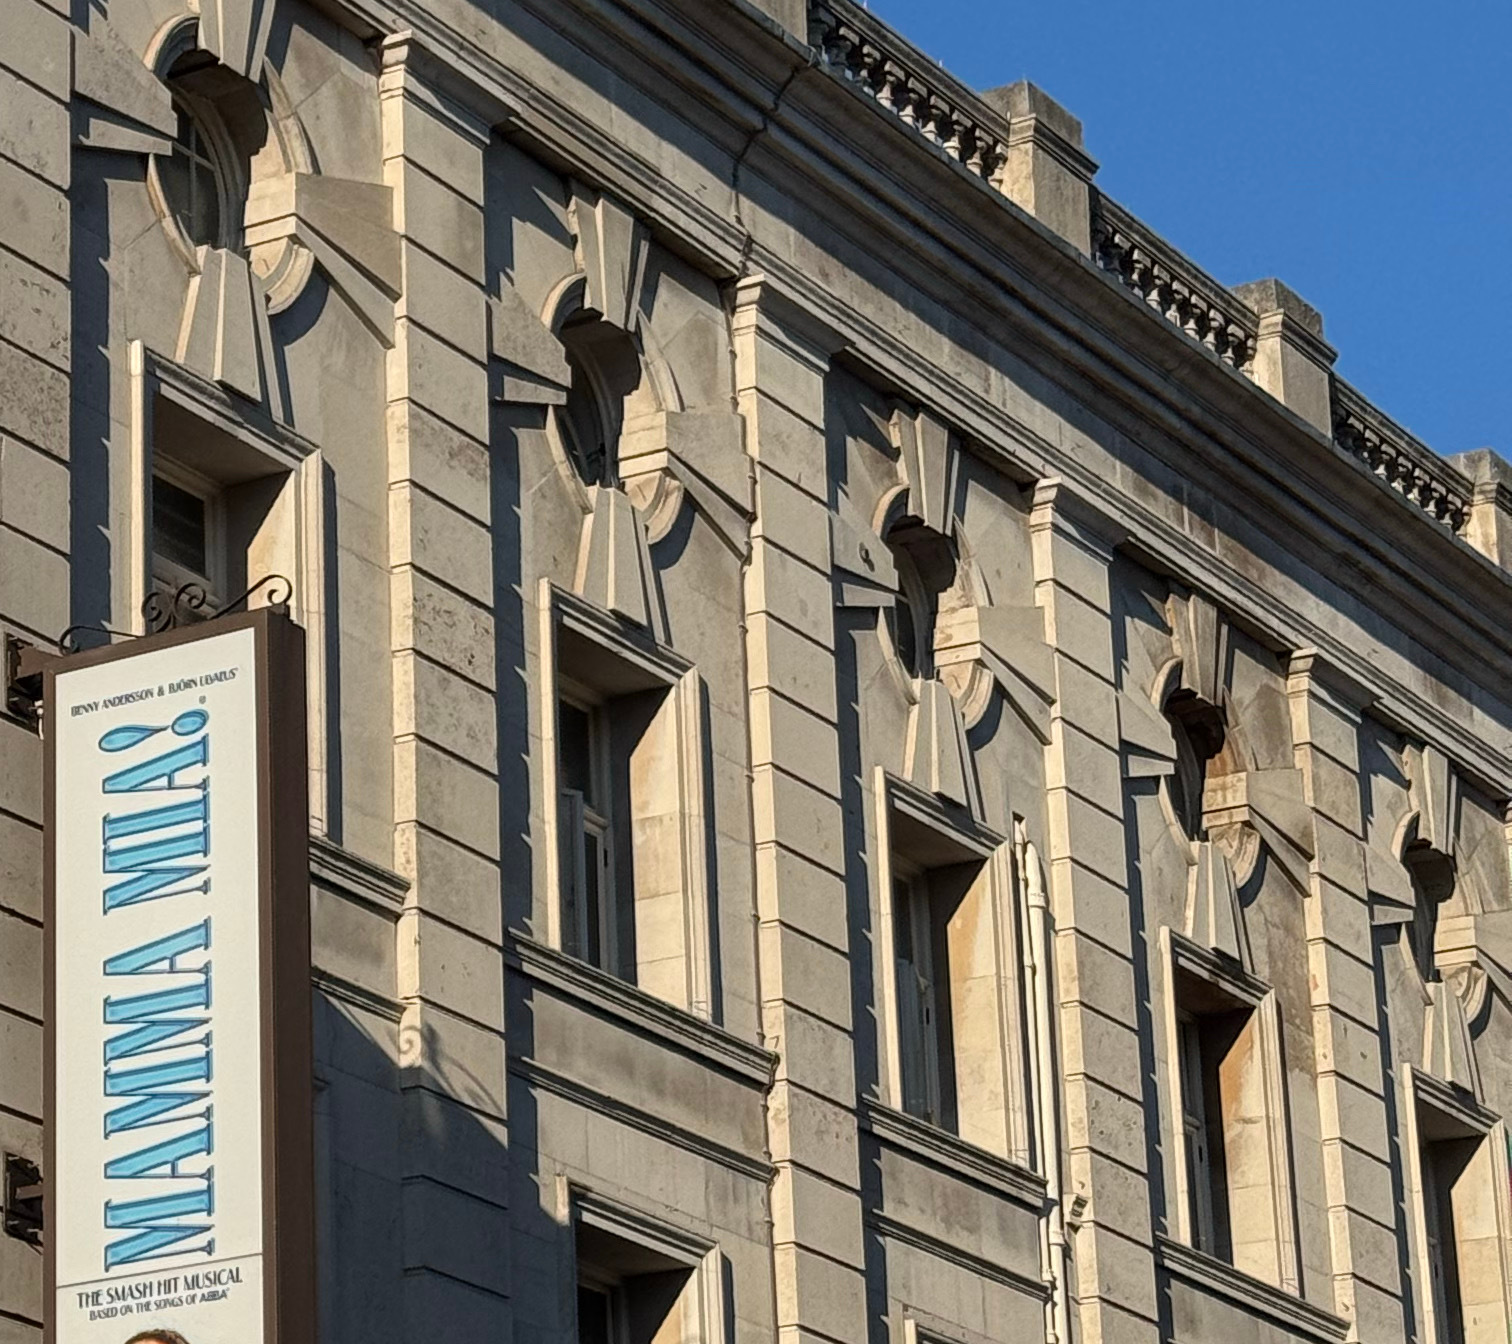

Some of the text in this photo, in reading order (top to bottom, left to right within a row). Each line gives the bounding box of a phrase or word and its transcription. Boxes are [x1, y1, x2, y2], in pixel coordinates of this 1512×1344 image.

[102, 687, 154, 710] ANDERSSON
[157, 685, 165, 697] &
[98, 709, 214, 1272] MAMMA MIA!
[77, 1266, 244, 1310] THE SMASH HIT MUSICAL
[89, 1306, 118, 1321] BASED
[119, 1305, 133, 1316] ON
[136, 1300, 152, 1314] THE
[154, 1295, 184, 1311] SONGS
